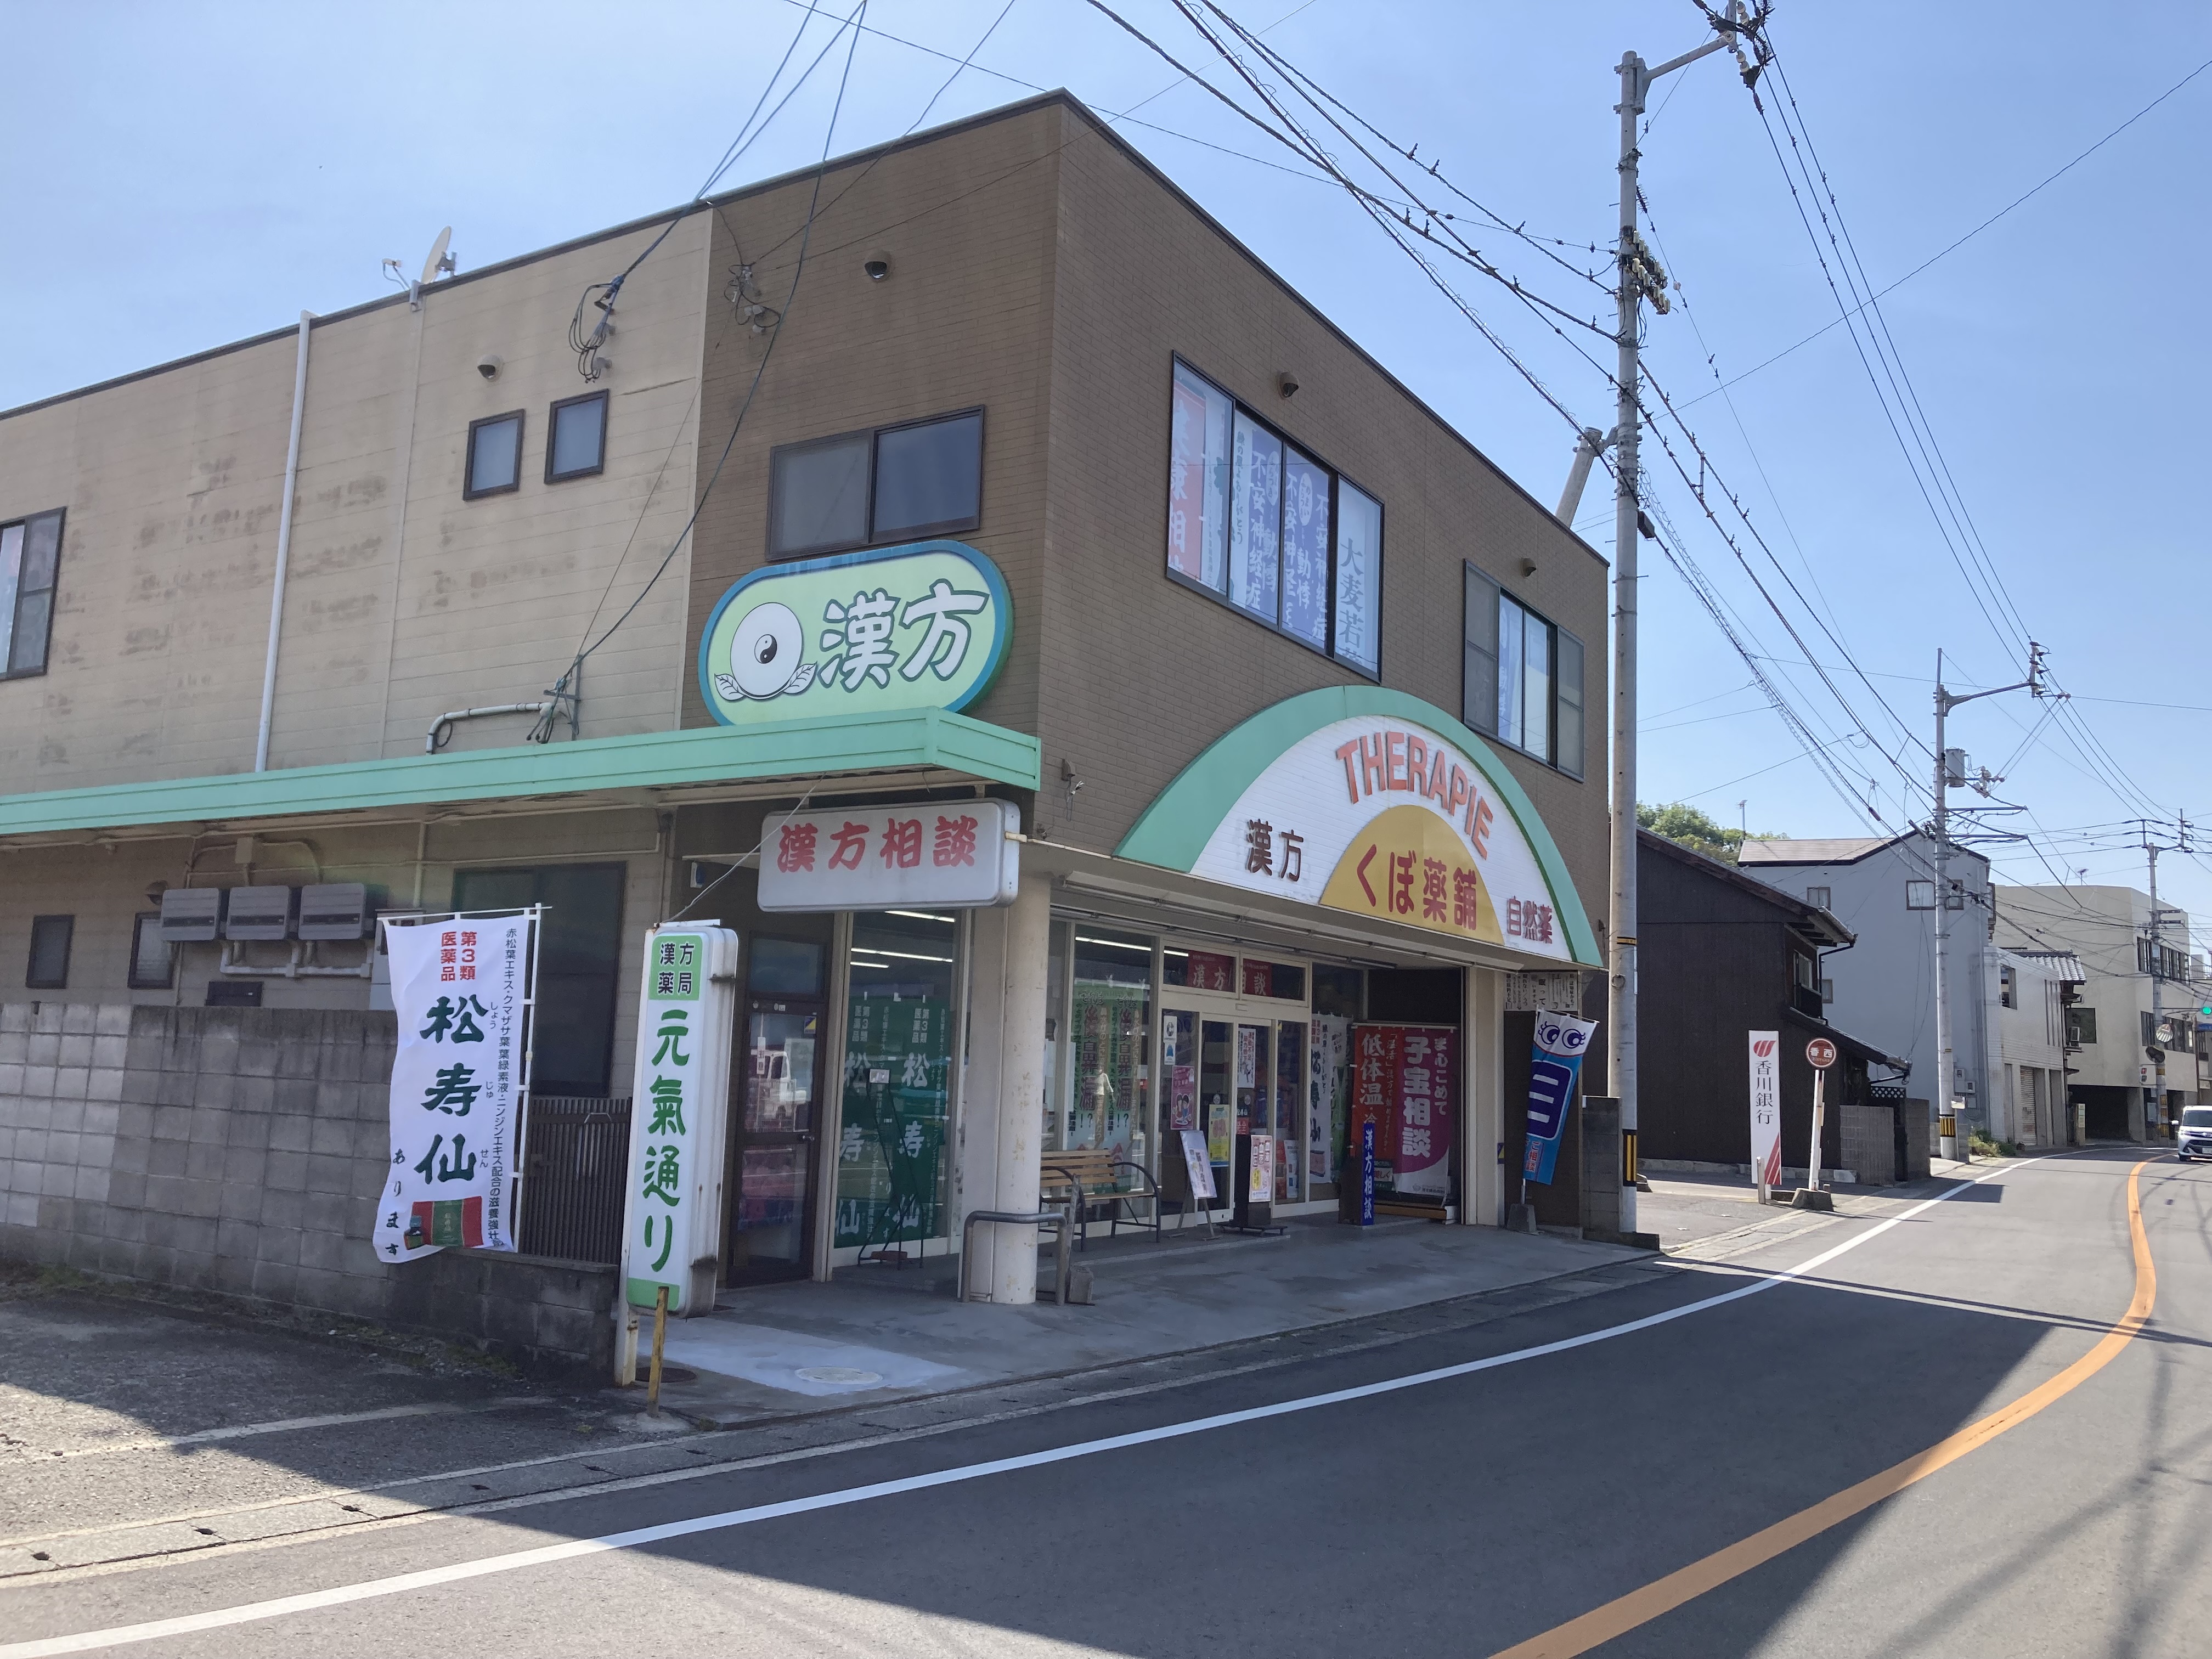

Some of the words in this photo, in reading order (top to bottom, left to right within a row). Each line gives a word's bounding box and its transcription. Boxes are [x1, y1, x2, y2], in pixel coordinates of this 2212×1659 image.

[1246, 451, 1267, 609] 不安神経症
[1262, 528, 1277, 592] 動悸
[1296, 550, 1311, 608] 動悸
[817, 579, 990, 692] 漢方
[1335, 731, 1493, 860] THERAPIE
[777, 815, 979, 873] 漢方相談
[1246, 819, 1304, 882] 漢方
[1357, 844, 1477, 930] くぼ薬舗
[1507, 896, 1553, 944] 自然薬
[441, 931, 457, 982] 医薬品
[459, 931, 477, 981] 第3類
[658, 972, 692, 995] 薬局
[659, 942, 695, 966] 漢方
[489, 1002, 498, 1029] しょう
[1435, 1037, 1448, 1115] ま心こめて
[1810, 1047, 1833, 1058] 香西
[414, 994, 488, 1185] 松寿仙
[486, 1081, 494, 1099] じゅ
[1402, 1036, 1431, 1158] 子宝相談
[1756, 1060, 1774, 1124] 香川銀行
[479, 1149, 489, 1169] せん
[642, 1009, 689, 1272] 元氣通り
[892, 1052, 931, 1229] 松寿仙
[385, 1148, 405, 1256] あります
